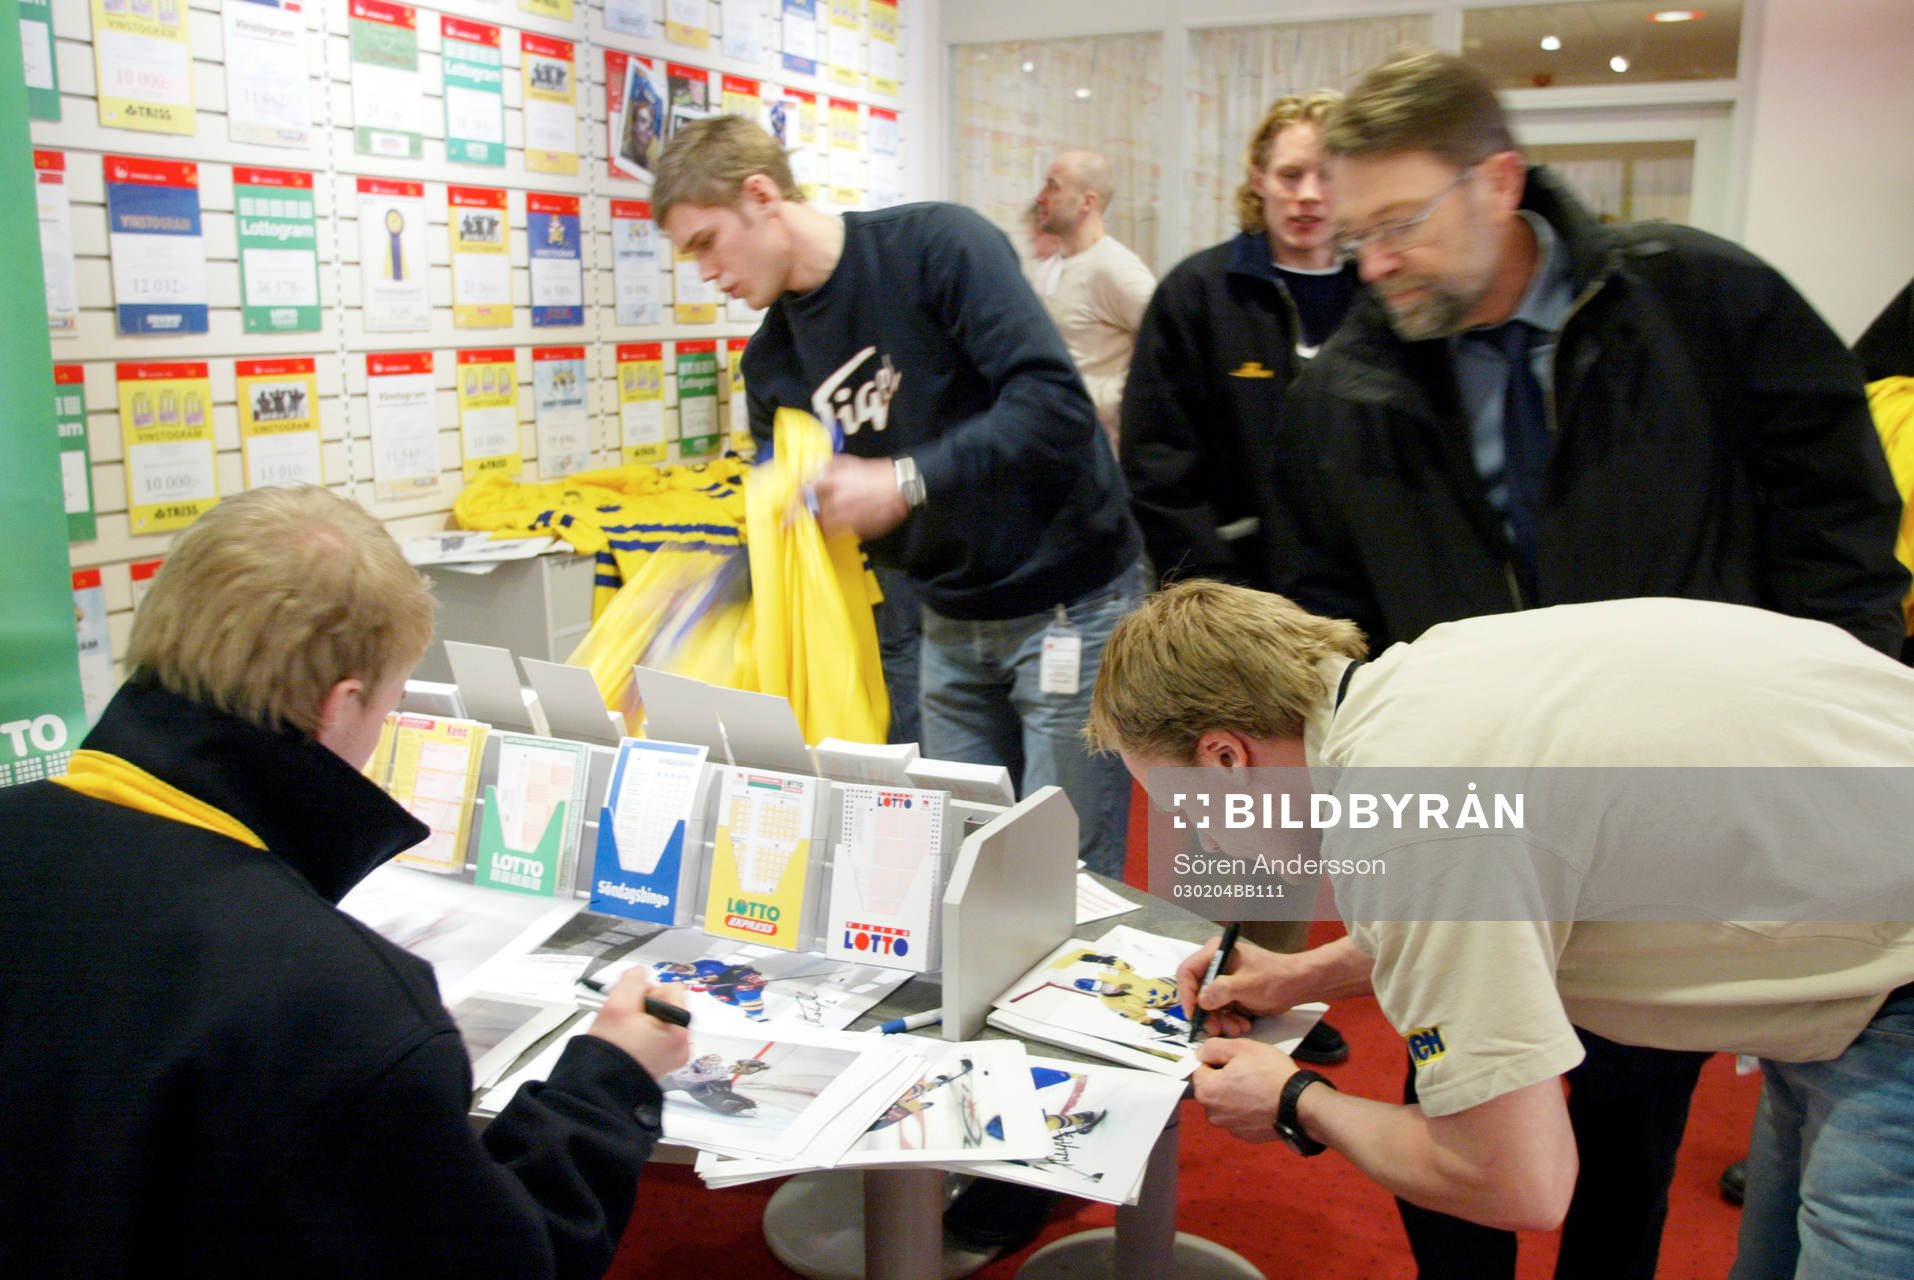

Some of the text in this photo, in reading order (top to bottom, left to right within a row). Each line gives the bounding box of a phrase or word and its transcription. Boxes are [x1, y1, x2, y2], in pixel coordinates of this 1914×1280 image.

[240, 218, 315, 241] Lottogram
[166, 504, 199, 518] TRISS
[877, 796, 912, 809] LOTTO
[492, 852, 544, 878] LOTTO
[597, 879, 670, 908] Söndagsbingo
[727, 897, 781, 922] LOTTO
[728, 917, 776, 935] EXPRESS
[844, 930, 909, 957] LOTTO
